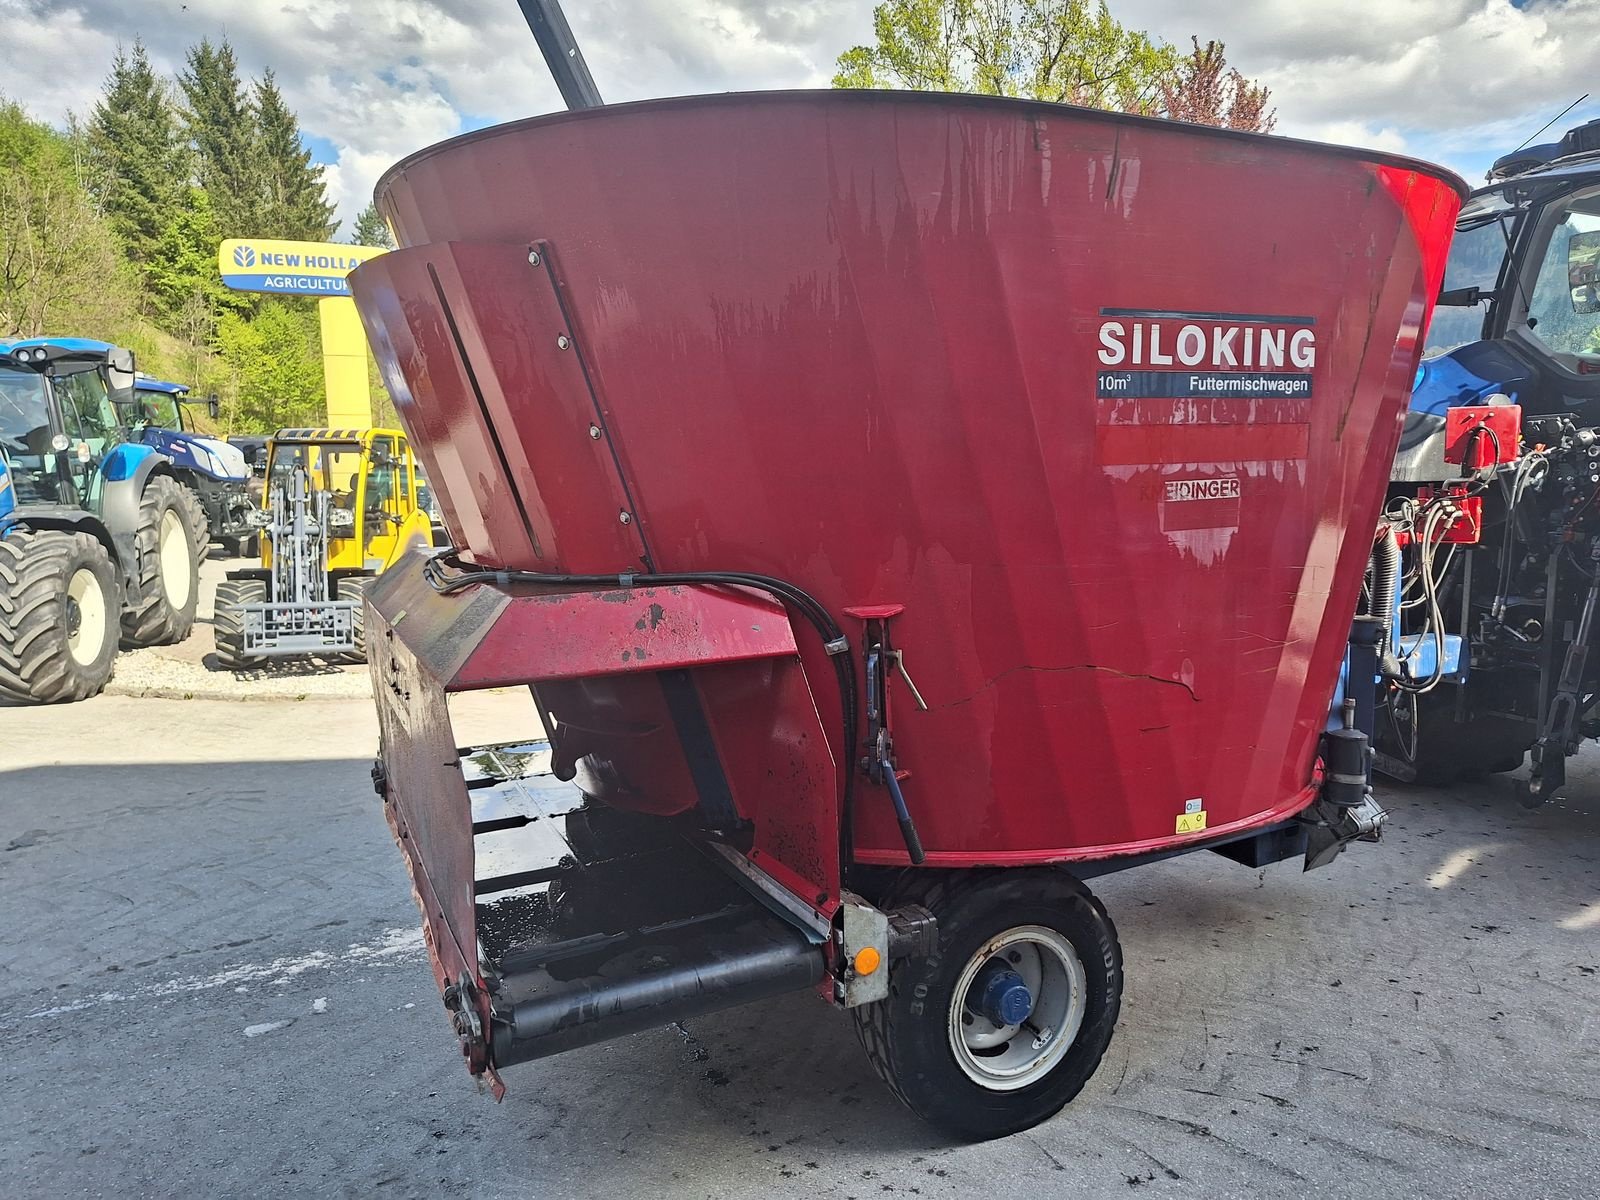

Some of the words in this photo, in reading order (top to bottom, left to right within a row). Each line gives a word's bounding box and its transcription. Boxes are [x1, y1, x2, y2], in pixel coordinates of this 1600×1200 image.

[261, 253, 300, 267] NEW
[305, 255, 364, 270] HOLLA
[1097, 321, 1316, 368] SILOKING
[1189, 376, 1309, 393] Futtermischwagen
